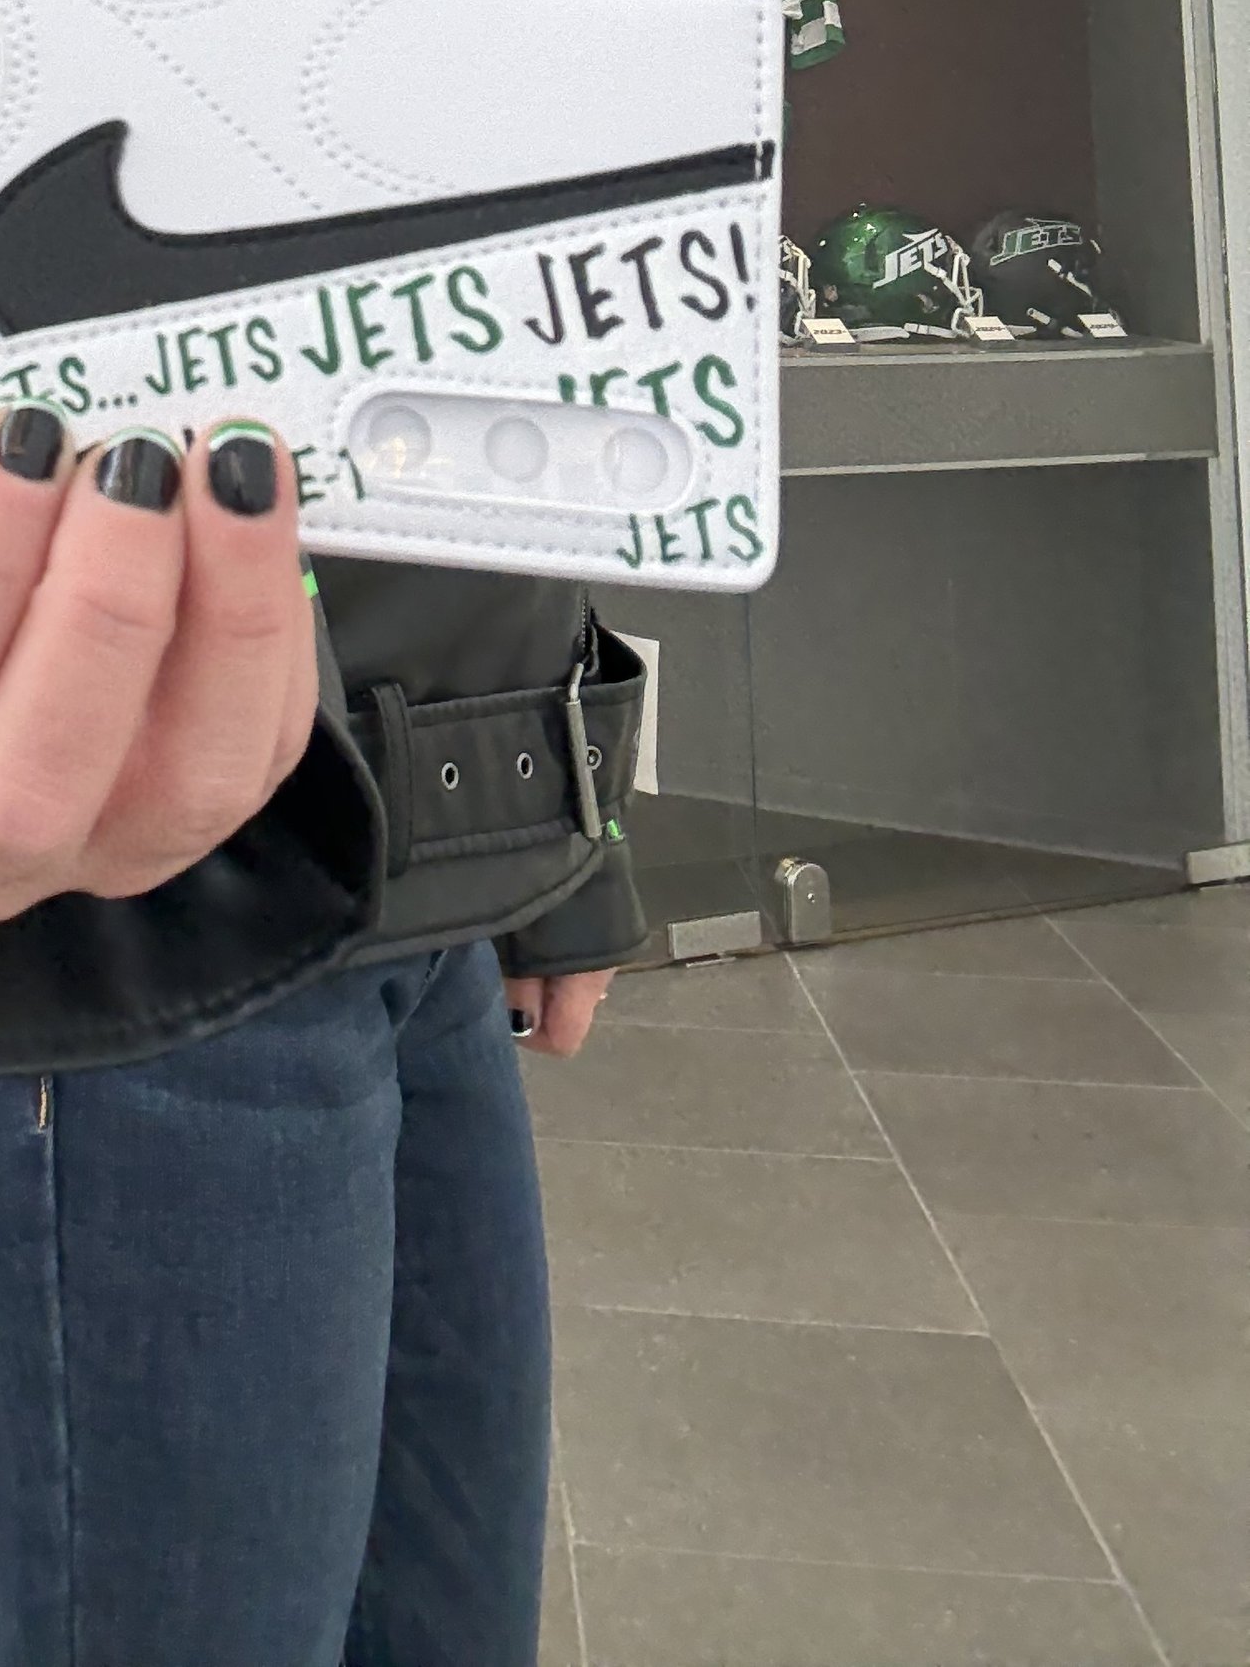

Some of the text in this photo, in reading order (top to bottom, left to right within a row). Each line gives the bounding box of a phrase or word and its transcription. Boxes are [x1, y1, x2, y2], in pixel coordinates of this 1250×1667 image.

[872, 228, 948, 290] JETS
[144, 317, 285, 396] JETS
[300, 266, 505, 378] JETS
[524, 222, 757, 346] JETS!
[617, 494, 765, 569] JETS
